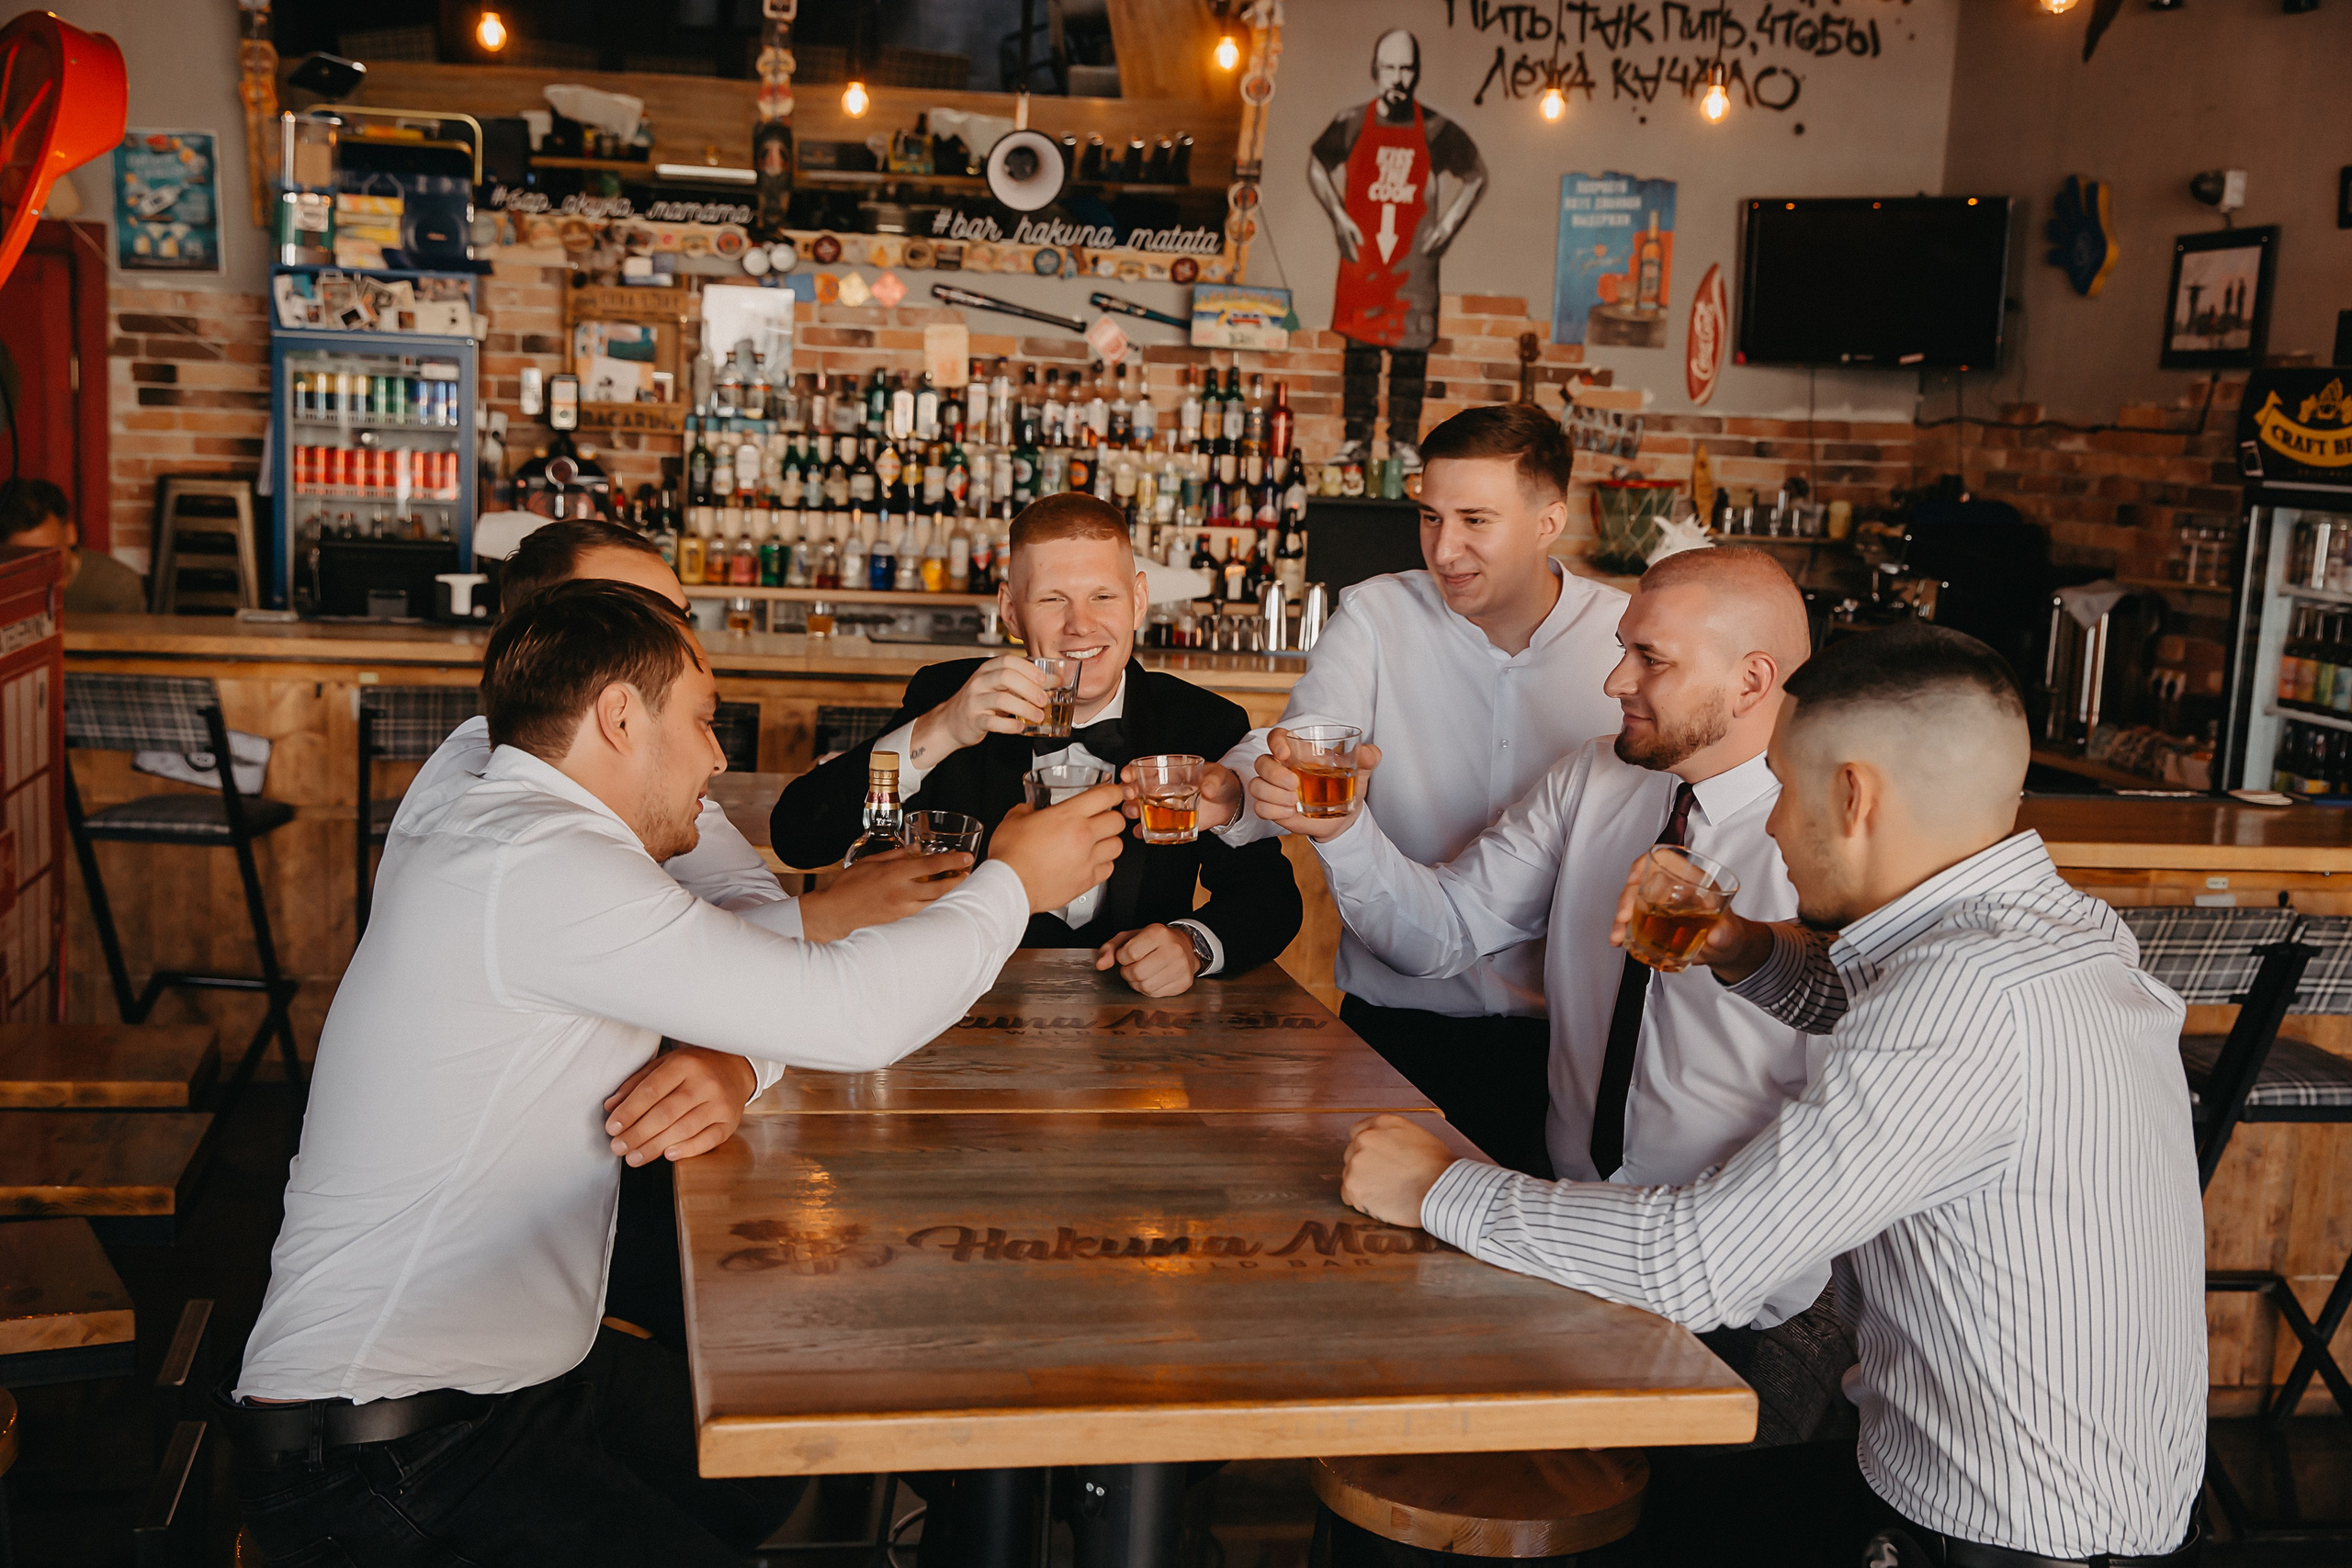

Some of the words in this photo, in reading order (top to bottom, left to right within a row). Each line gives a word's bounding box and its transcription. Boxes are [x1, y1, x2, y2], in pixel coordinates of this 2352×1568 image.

[1566, 1, 1654, 51] ТАК
[1756, 3, 1882, 58] ЧТОБЫ
[1367, 182, 1418, 204] COOK
[932, 208, 1003, 243] #bar
[1011, 214, 1116, 250] hakuna
[1124, 224, 1220, 255] matata
[2271, 424, 2325, 456] CRAFT
[906, 1224, 1263, 1263] Hakuna
[1288, 1258, 1374, 1268] BAR
